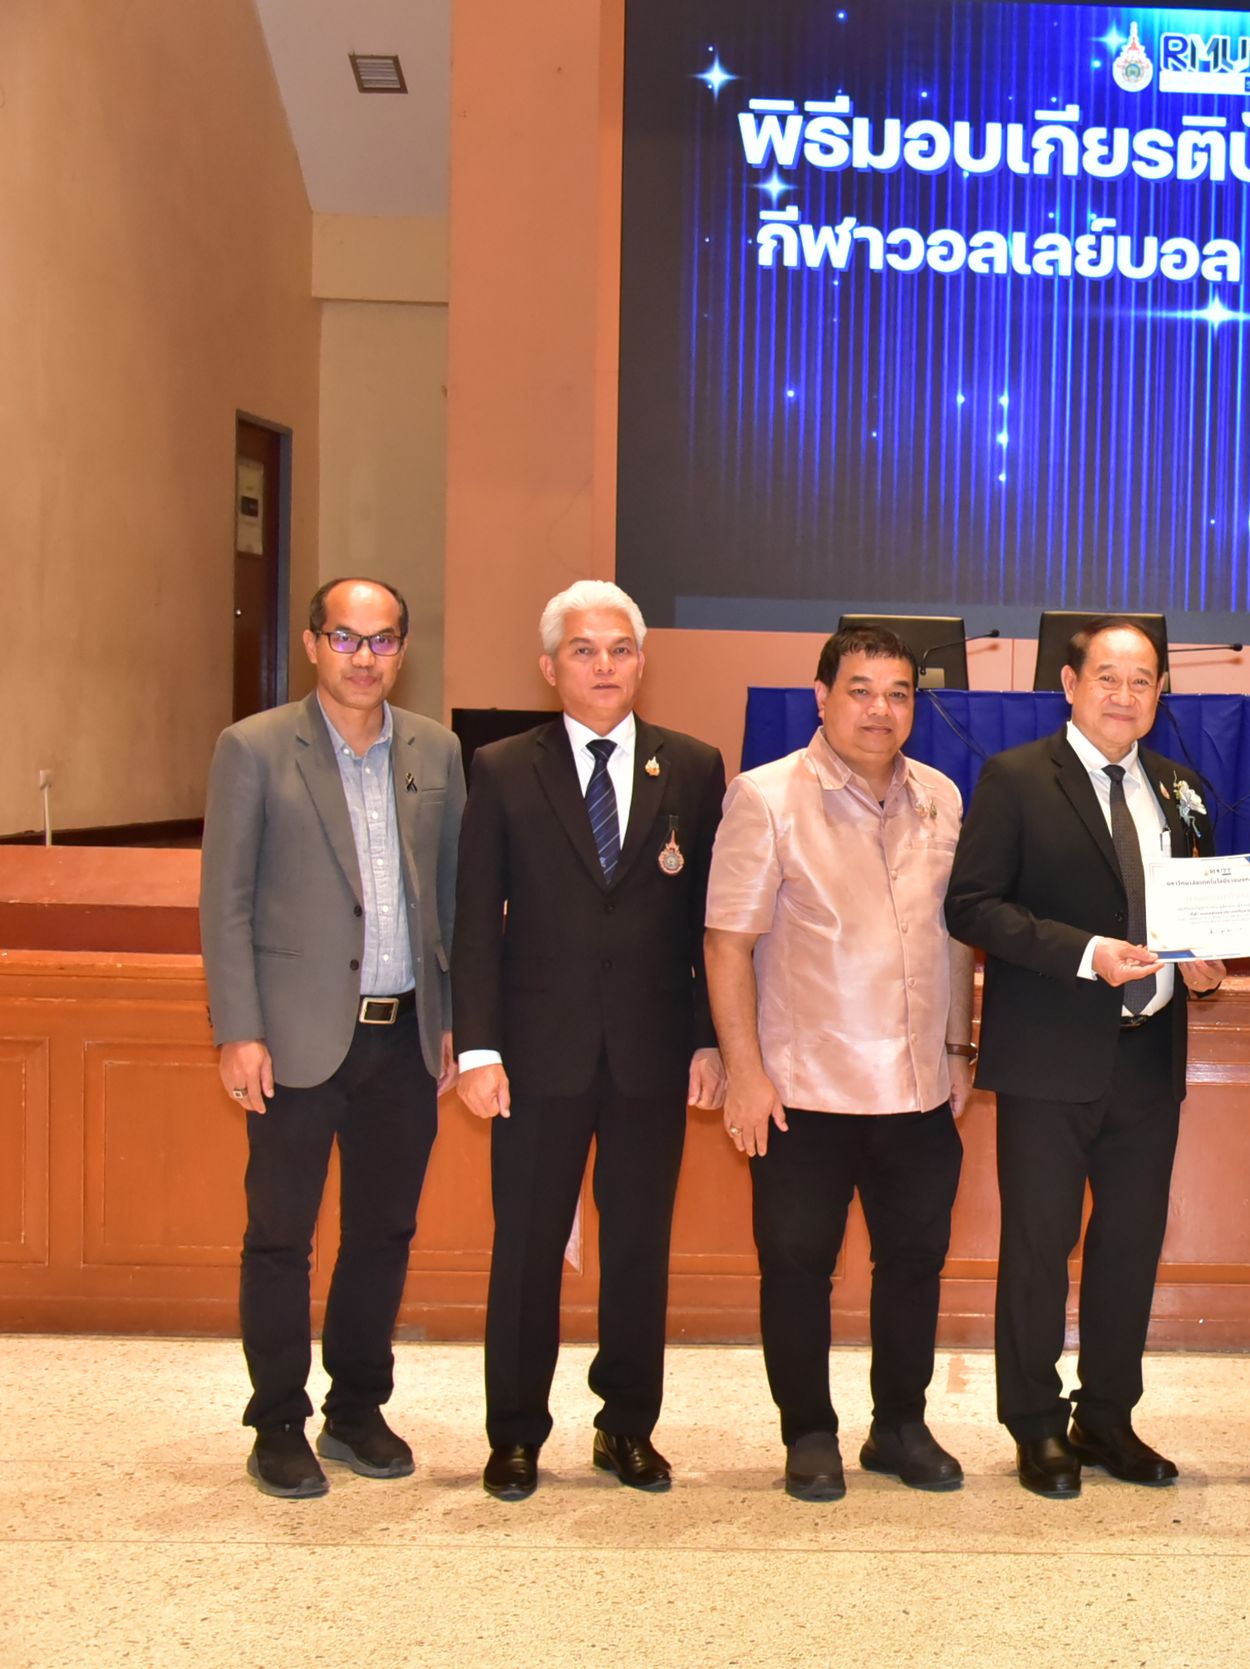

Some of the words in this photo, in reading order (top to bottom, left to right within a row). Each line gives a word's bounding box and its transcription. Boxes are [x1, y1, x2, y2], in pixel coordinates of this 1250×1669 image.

[757, 206, 1241, 283] กีฬาวอลเลย์บอล
